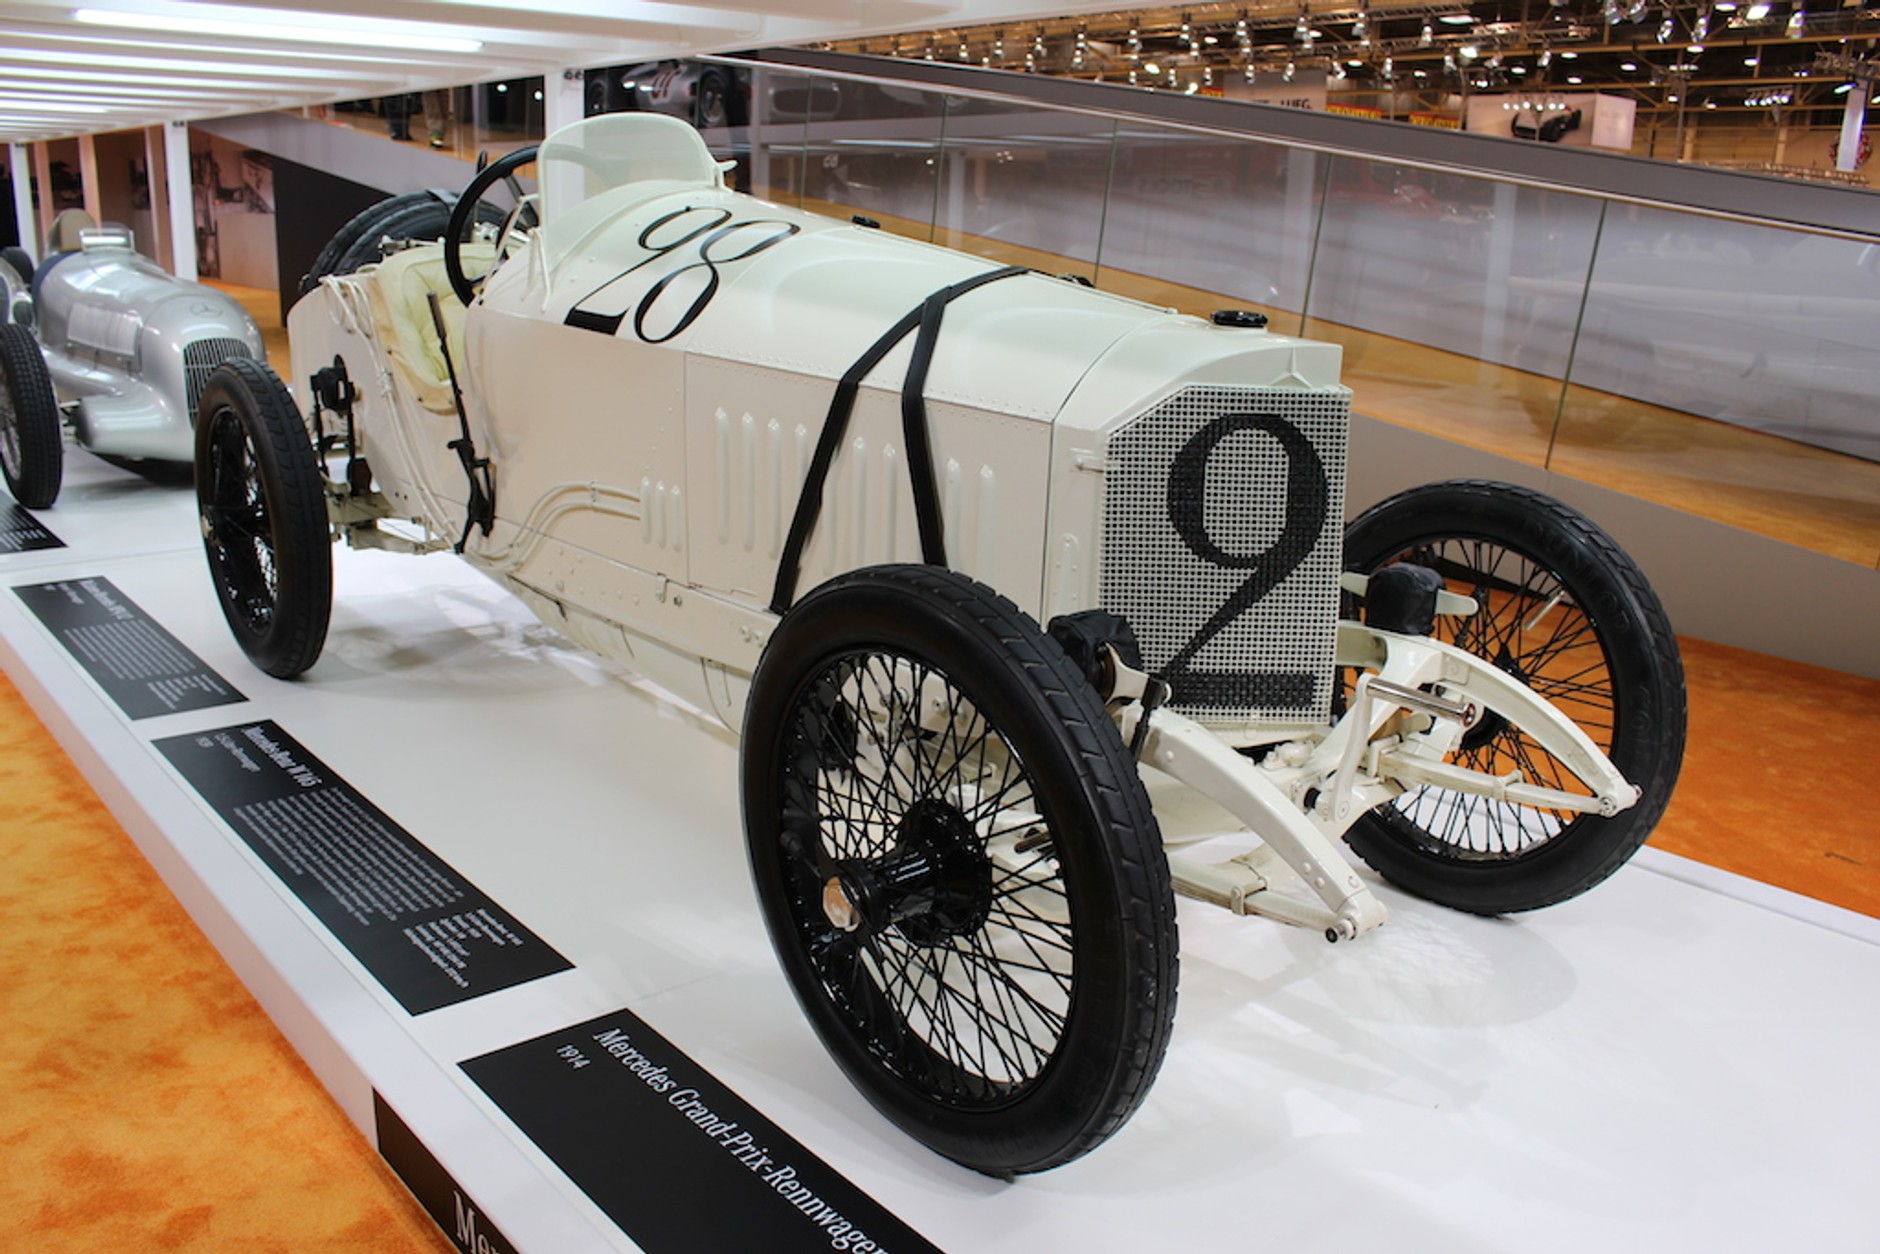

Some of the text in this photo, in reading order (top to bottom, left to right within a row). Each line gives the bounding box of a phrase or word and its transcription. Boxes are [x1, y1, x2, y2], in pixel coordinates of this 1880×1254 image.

[563, 206, 801, 343] 28
[556, 1044, 591, 1069] 1914
[592, 1027, 678, 1094] Mercedes
[453, 1190, 499, 1254] Me
